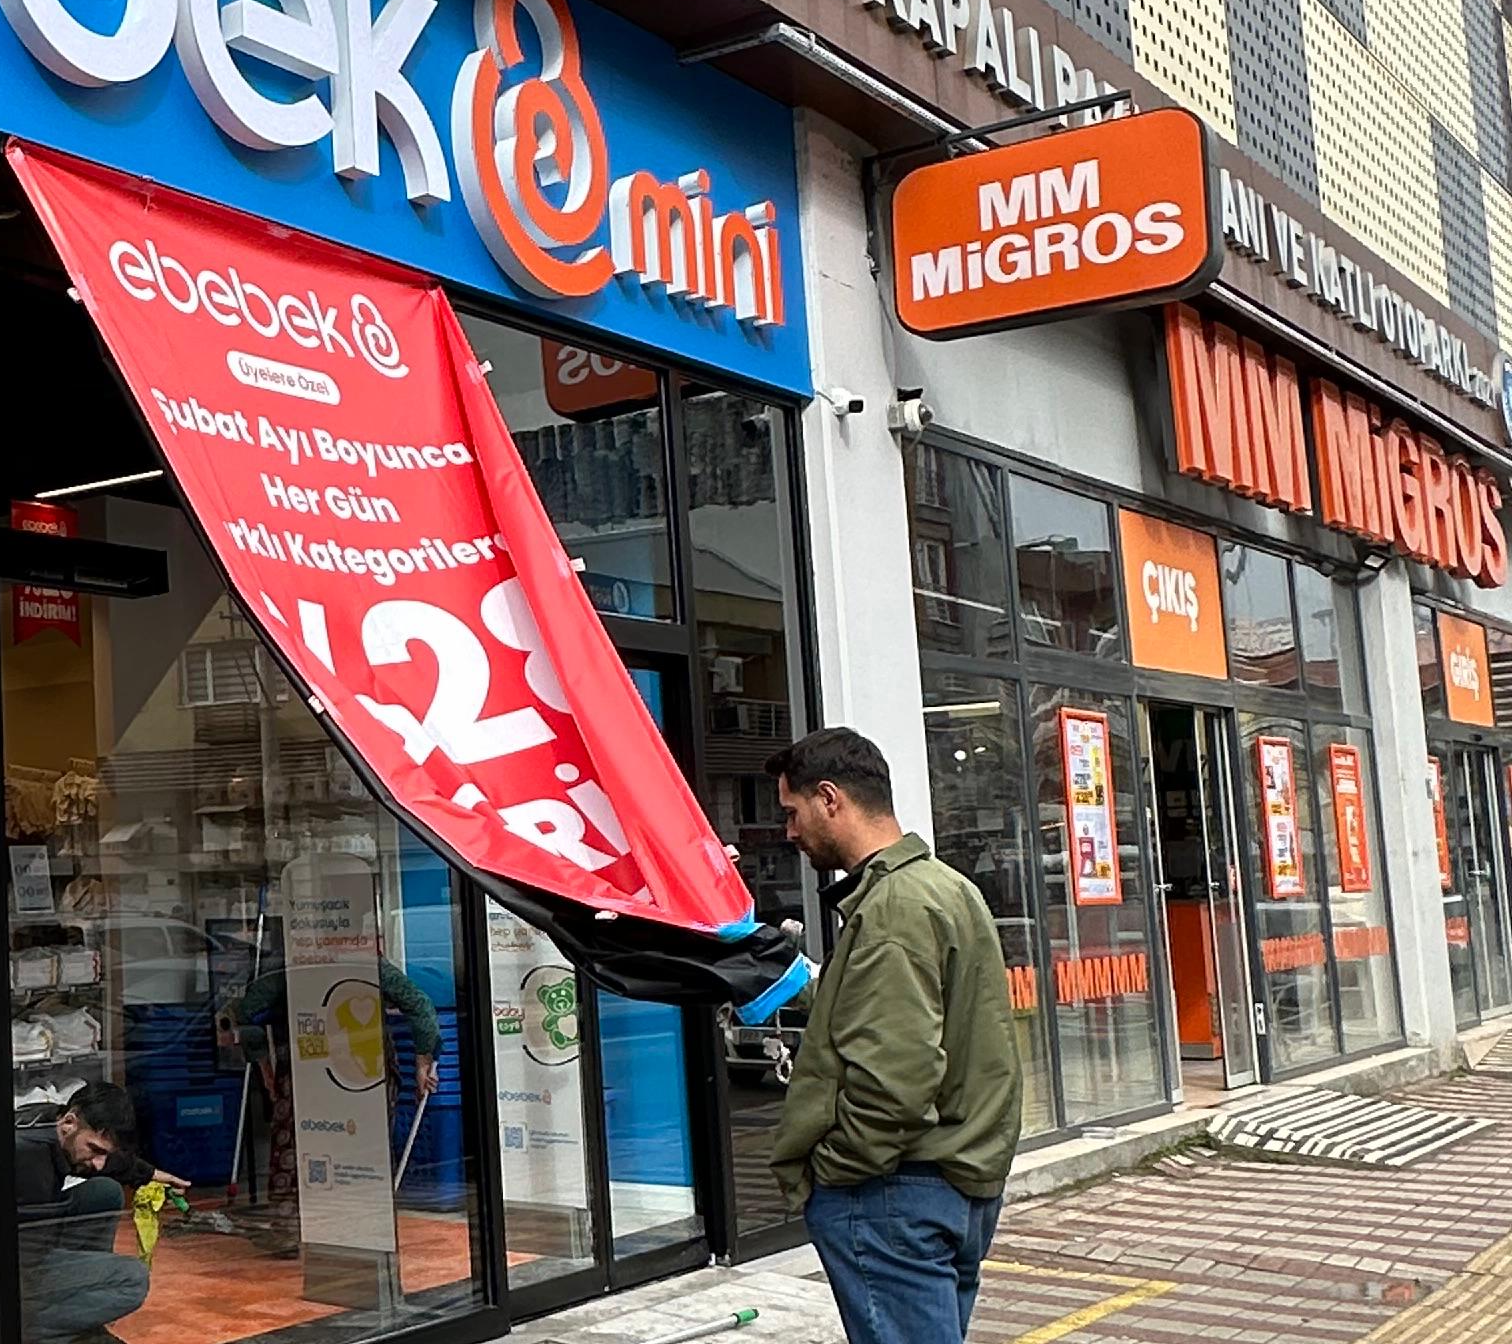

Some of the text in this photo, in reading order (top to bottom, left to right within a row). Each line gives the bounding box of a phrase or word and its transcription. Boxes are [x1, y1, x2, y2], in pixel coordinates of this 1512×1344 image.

[978, 159, 1100, 232] MM
[610, 168, 784, 327] mini
[910, 201, 1185, 302] MiGROS
[1268, 203, 1308, 289] VE
[1307, 232, 1378, 333] KATLI
[108, 239, 355, 359] ebebek
[297, 368, 331, 397] Özel
[258, 415, 315, 466] Ayı
[311, 429, 474, 478] Boyunca
[1164, 302, 1508, 588] MM MiGROS
[258, 472, 402, 524] Her Gün
[223, 518, 288, 562] rklı
[1142, 559, 1200, 632] ÇIKIŞ
[297, 1016, 326, 1036] hello
